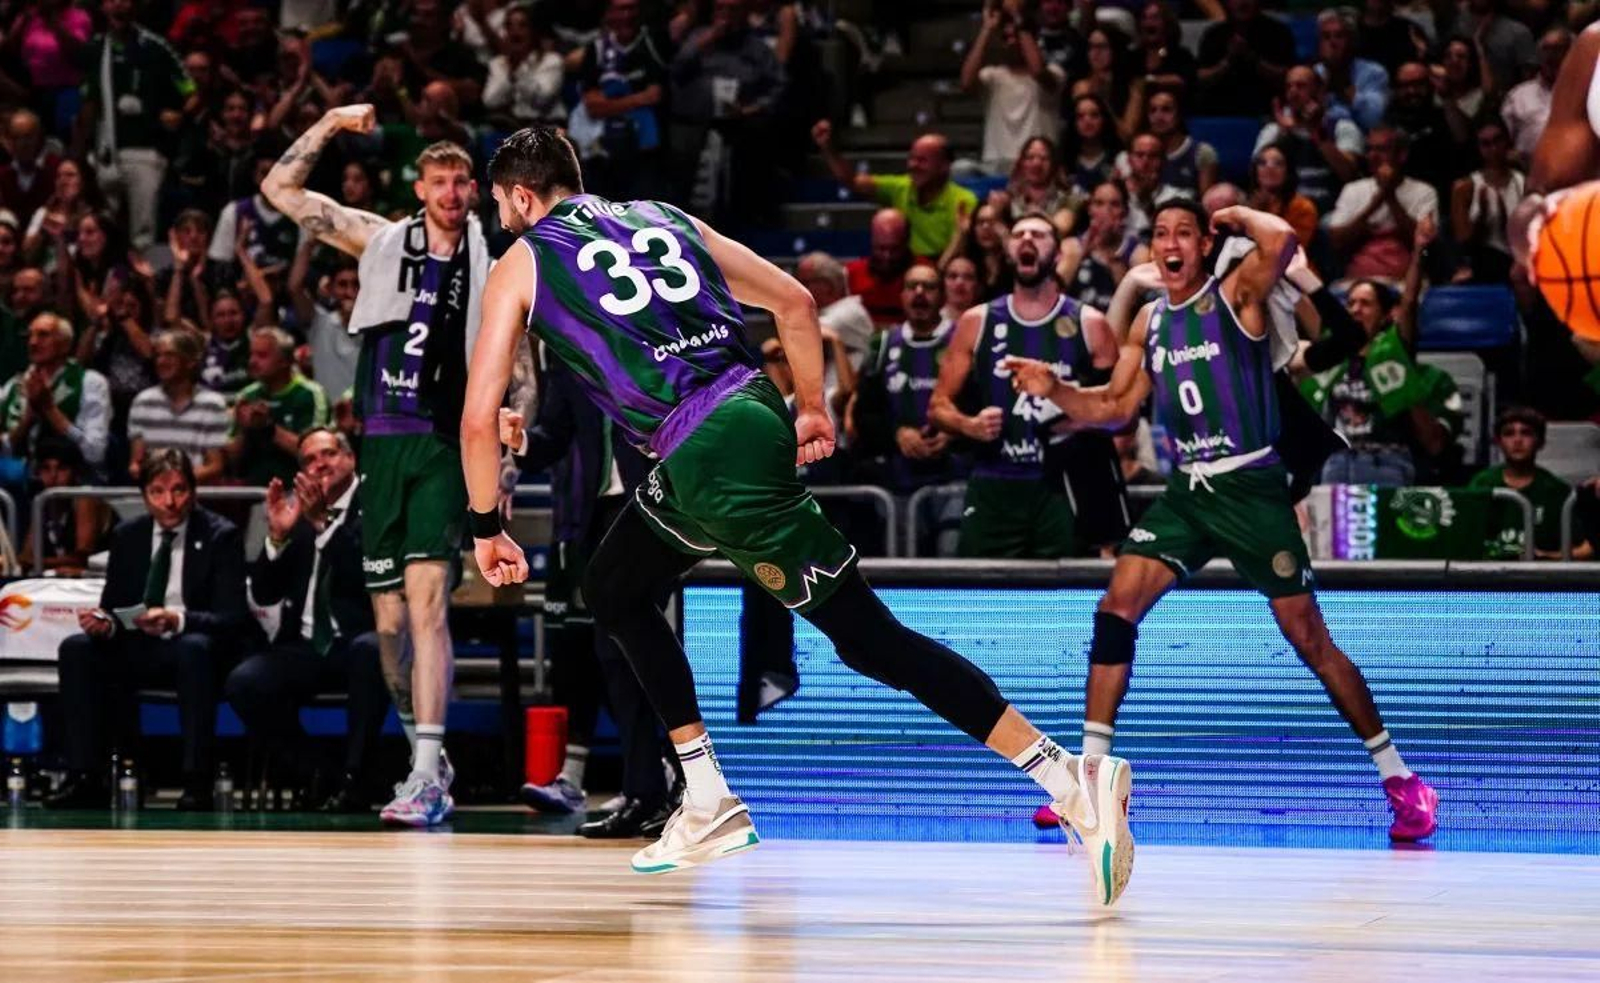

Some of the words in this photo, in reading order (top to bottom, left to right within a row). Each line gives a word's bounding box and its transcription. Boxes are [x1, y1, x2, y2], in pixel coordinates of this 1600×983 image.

[577, 227, 701, 315] 33
[403, 322, 429, 357] 2
[1178, 380, 1204, 416] 0
